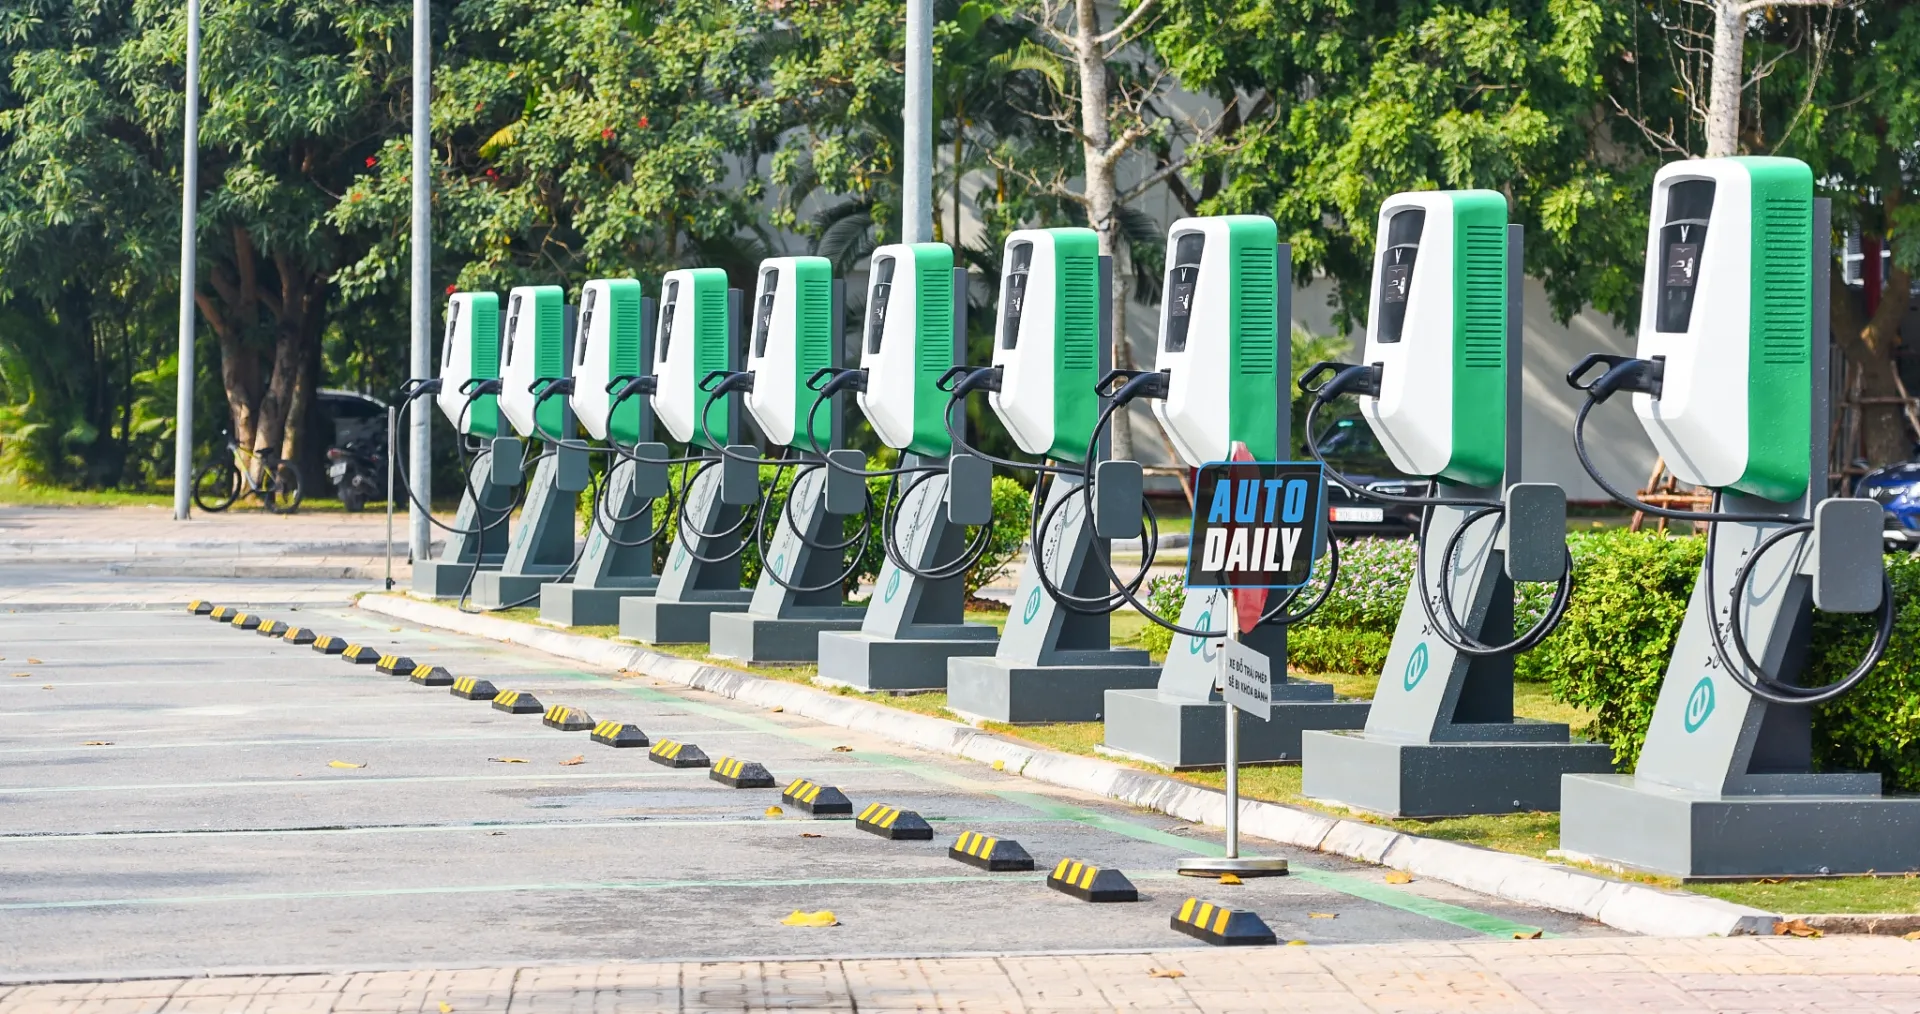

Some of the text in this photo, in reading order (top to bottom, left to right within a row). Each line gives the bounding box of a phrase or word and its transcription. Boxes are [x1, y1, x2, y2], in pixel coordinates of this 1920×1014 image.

[1229, 658, 1236, 670] XE
[1254, 670, 1267, 684] PHÉP
[1254, 687, 1269, 703] BÁNH
